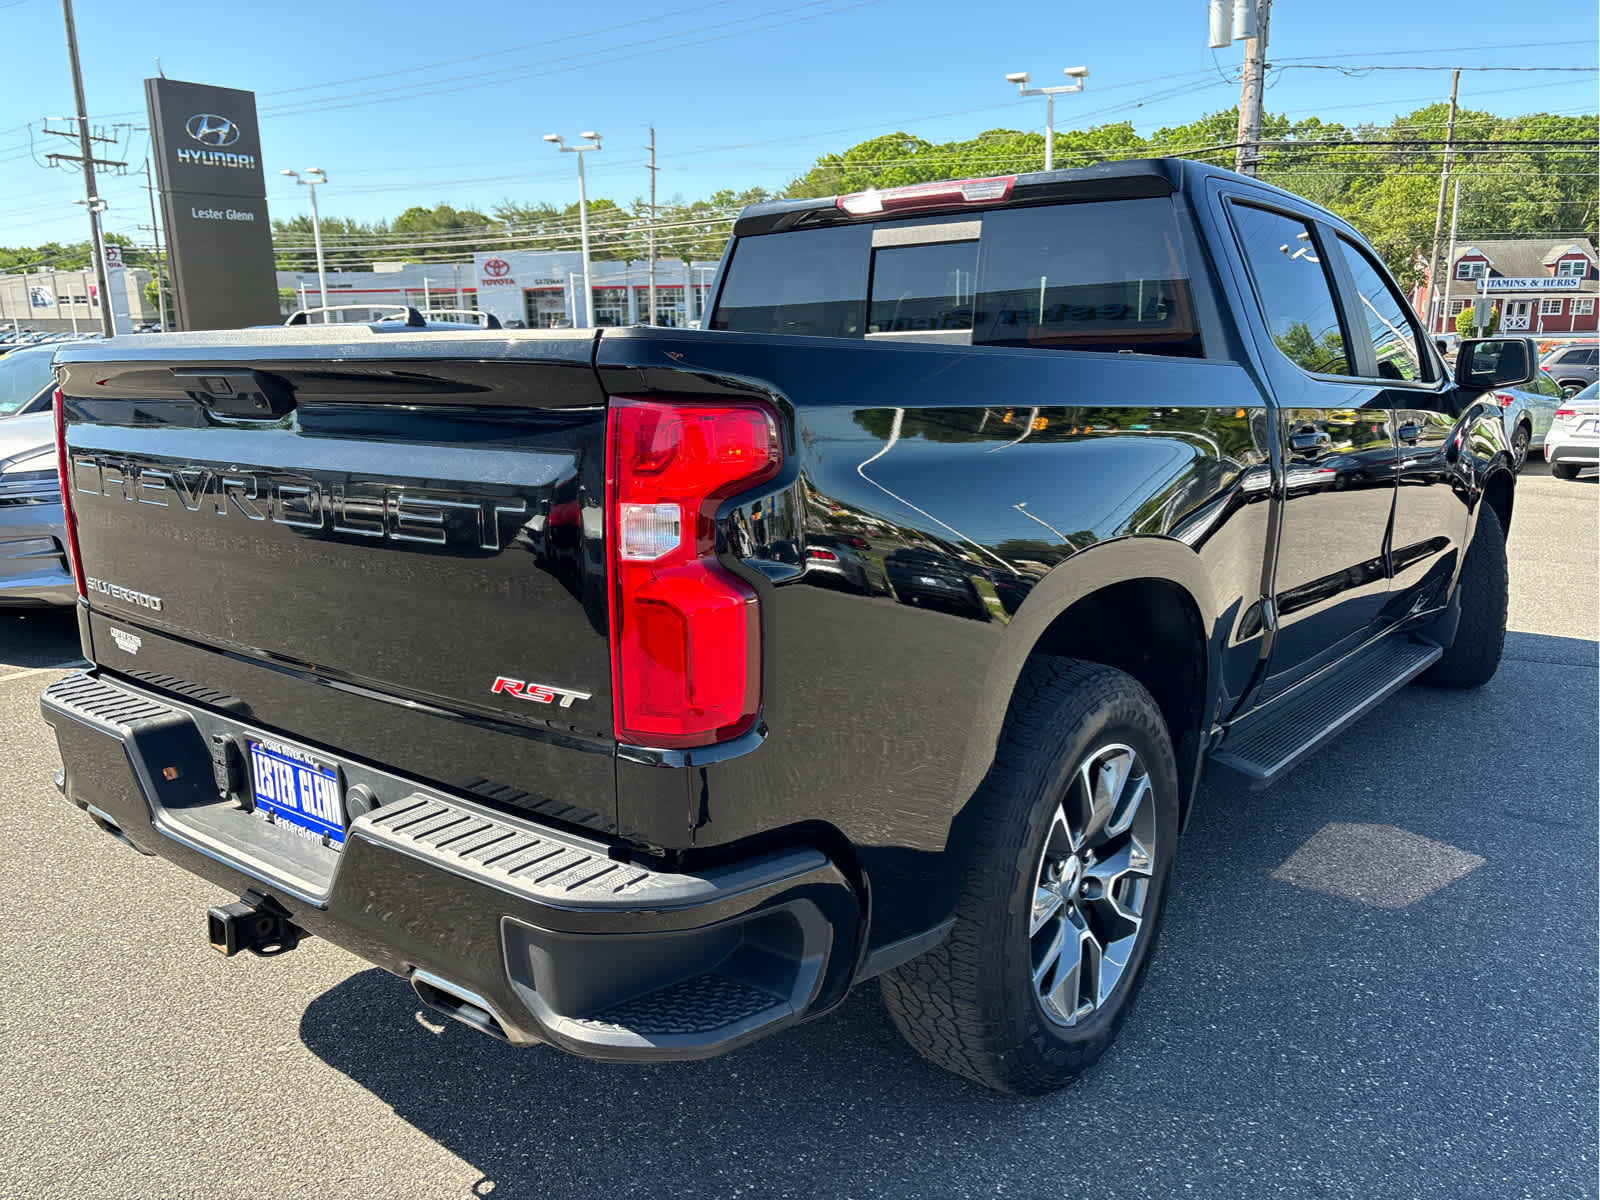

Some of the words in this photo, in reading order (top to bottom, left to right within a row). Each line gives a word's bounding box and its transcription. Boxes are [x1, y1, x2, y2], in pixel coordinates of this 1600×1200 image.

[177, 147, 256, 169] HYUNDAI
[191, 207, 223, 220] Lester
[225, 208, 255, 222] Glenn
[481, 278, 516, 286] TOYOTA
[1480, 278, 1527, 288] VITAMINS
[1530, 279, 1540, 287] &
[1542, 278, 1577, 287] HERBS
[70, 454, 528, 550] CHEVROLET
[86, 576, 163, 611] SILVERADO
[491, 675, 592, 708] RST
[251, 750, 298, 809] LESTER
[299, 769, 342, 826] GLENN
